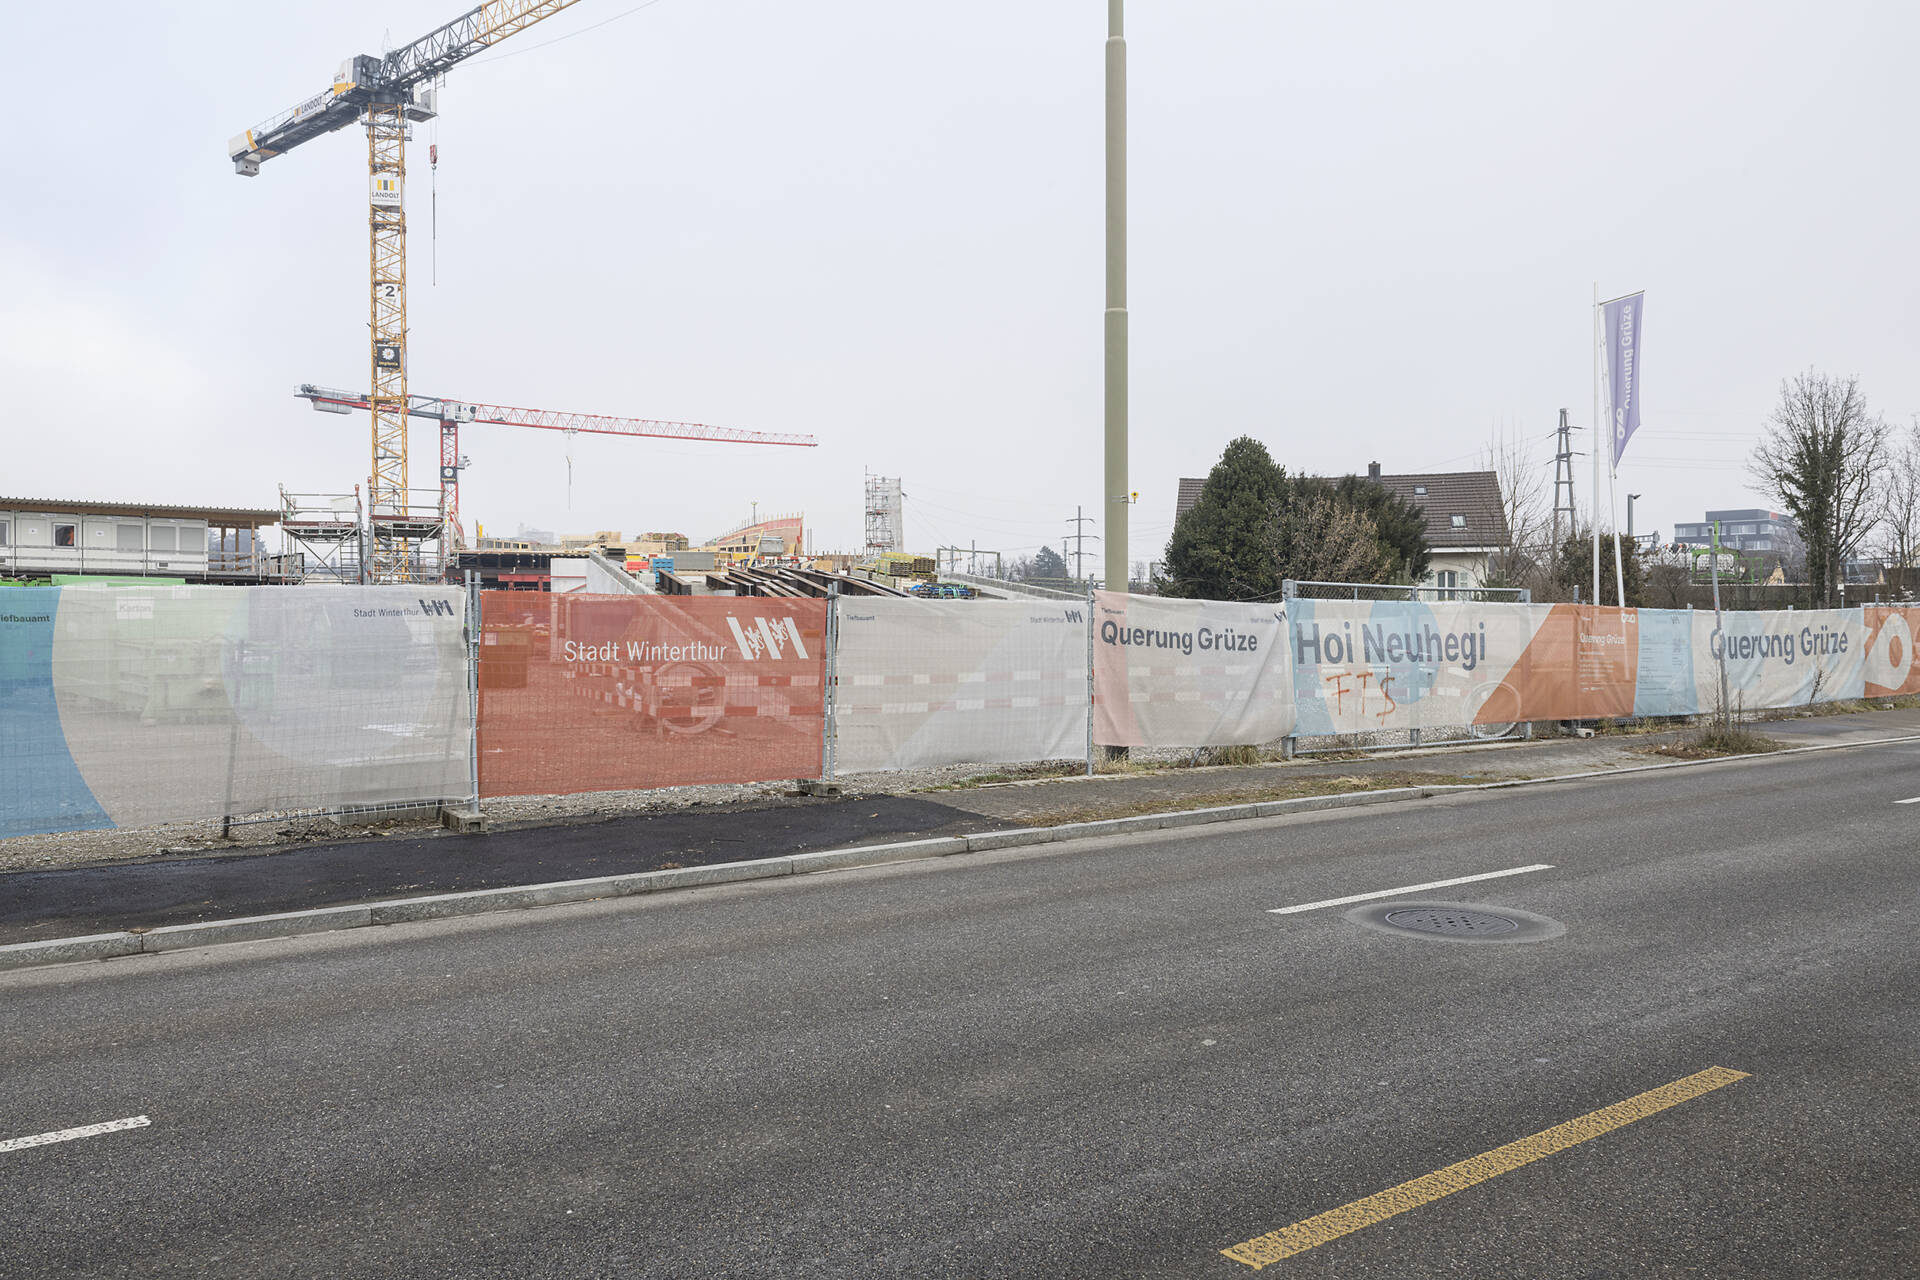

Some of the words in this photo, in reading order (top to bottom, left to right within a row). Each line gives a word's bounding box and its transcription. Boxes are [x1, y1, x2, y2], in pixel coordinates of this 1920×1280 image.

[301, 96, 323, 113] LANDOLT
[385, 285, 395, 297] 2
[1621, 304, 1633, 347] Grüze
[0, 614, 50, 623] iefbauamt
[353, 608, 376, 618] Stadt
[378, 607, 419, 617] Winterthur
[1101, 620, 1193, 656] Querung
[1198, 628, 1258, 652] Grüze
[1296, 621, 1354, 665] Hoi
[1361, 621, 1486, 672] Neuhegi
[1710, 628, 1795, 665] Querung
[1800, 625, 1849, 657] Grüze
[563, 639, 620, 663] Stadt
[626, 640, 728, 662] Winterthur
